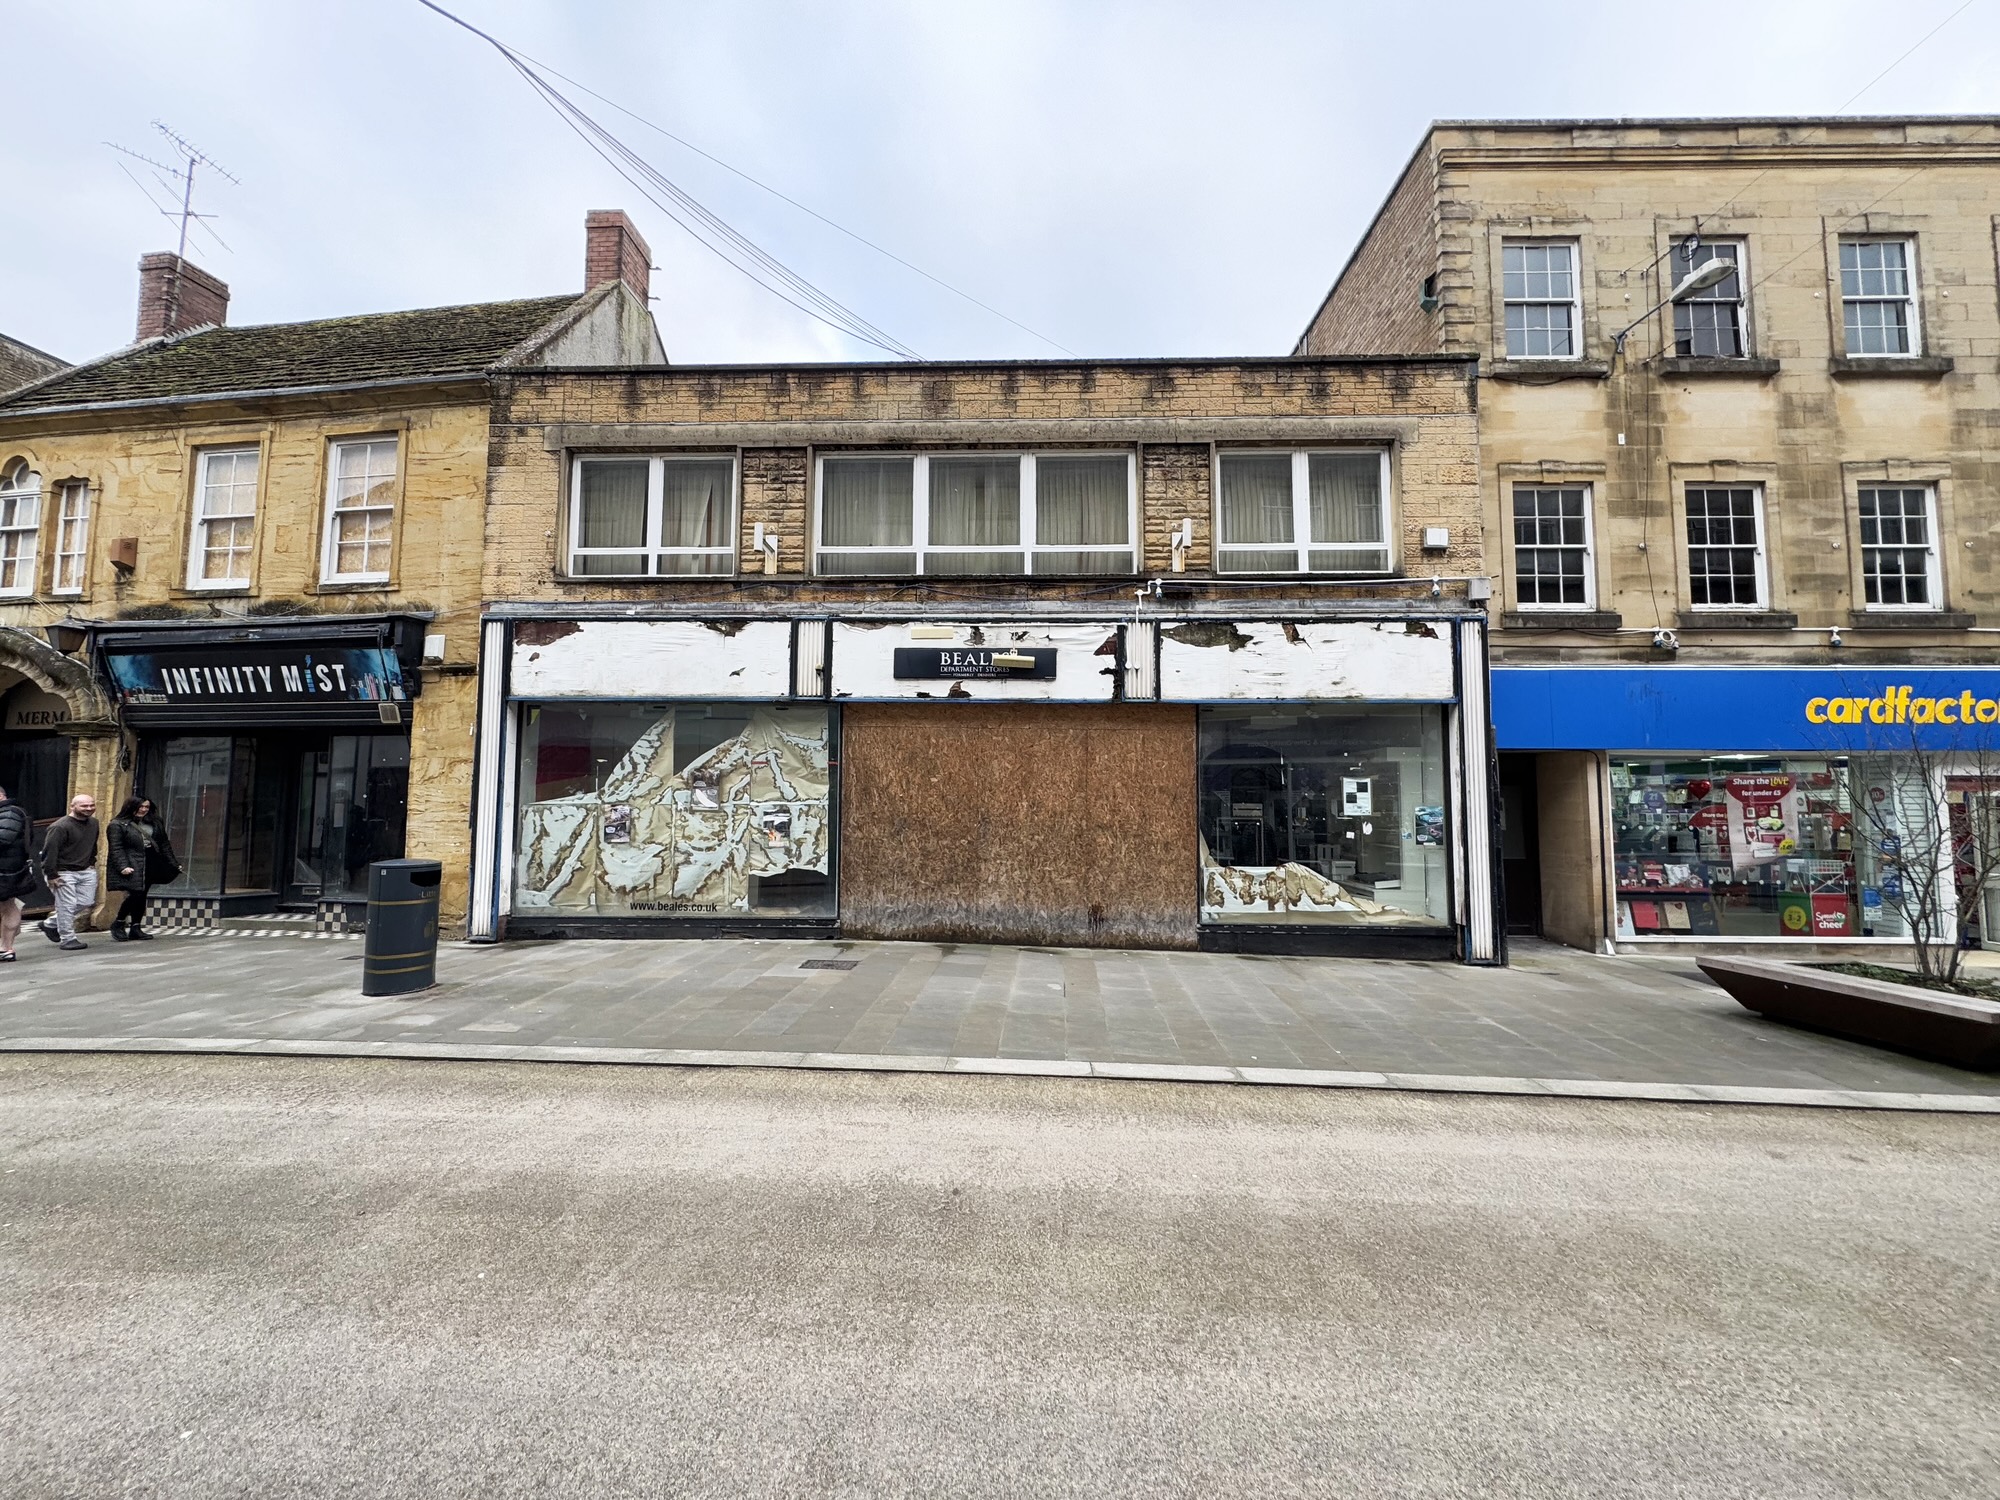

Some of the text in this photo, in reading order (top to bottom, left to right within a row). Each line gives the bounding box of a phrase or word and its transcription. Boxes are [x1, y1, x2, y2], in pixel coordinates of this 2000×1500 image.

[940, 652, 1010, 666] BEAL
[161, 666, 273, 694] INFINITY
[1805, 685, 2000, 724] cardfacto
[1732, 777, 1756, 785] Share
[1756, 777, 1769, 785] the
[630, 901, 718, 912] www.beales.co.uk
[1819, 921, 1844, 929] cheer
